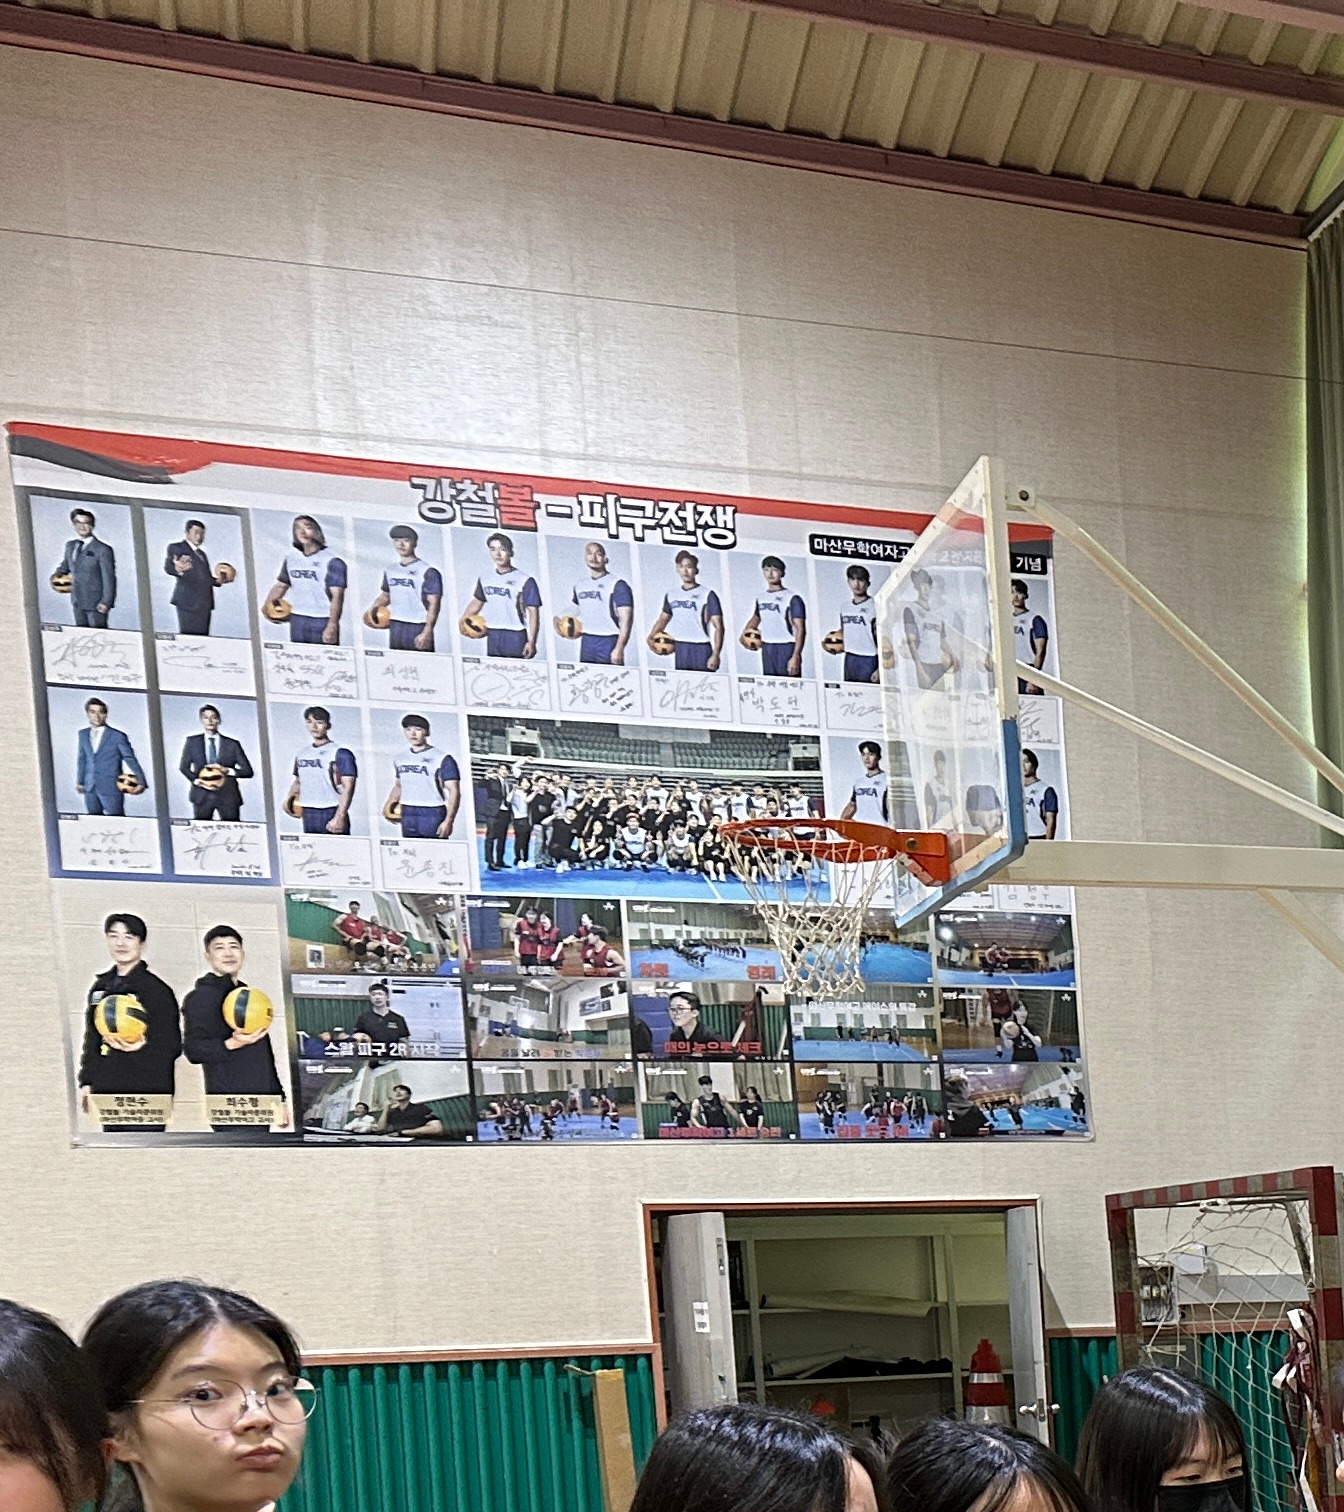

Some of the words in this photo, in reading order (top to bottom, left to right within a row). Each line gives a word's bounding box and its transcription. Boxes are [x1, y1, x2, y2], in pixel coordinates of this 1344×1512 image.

[410, 475, 541, 532] 강철볼
[577, 492, 737, 550] 피구전쟁
[1015, 556, 1042, 571] 기념
[357, 1043, 386, 1056] 피구
[389, 1043, 407, 1056] 2R
[664, 1041, 690, 1053] 매의
